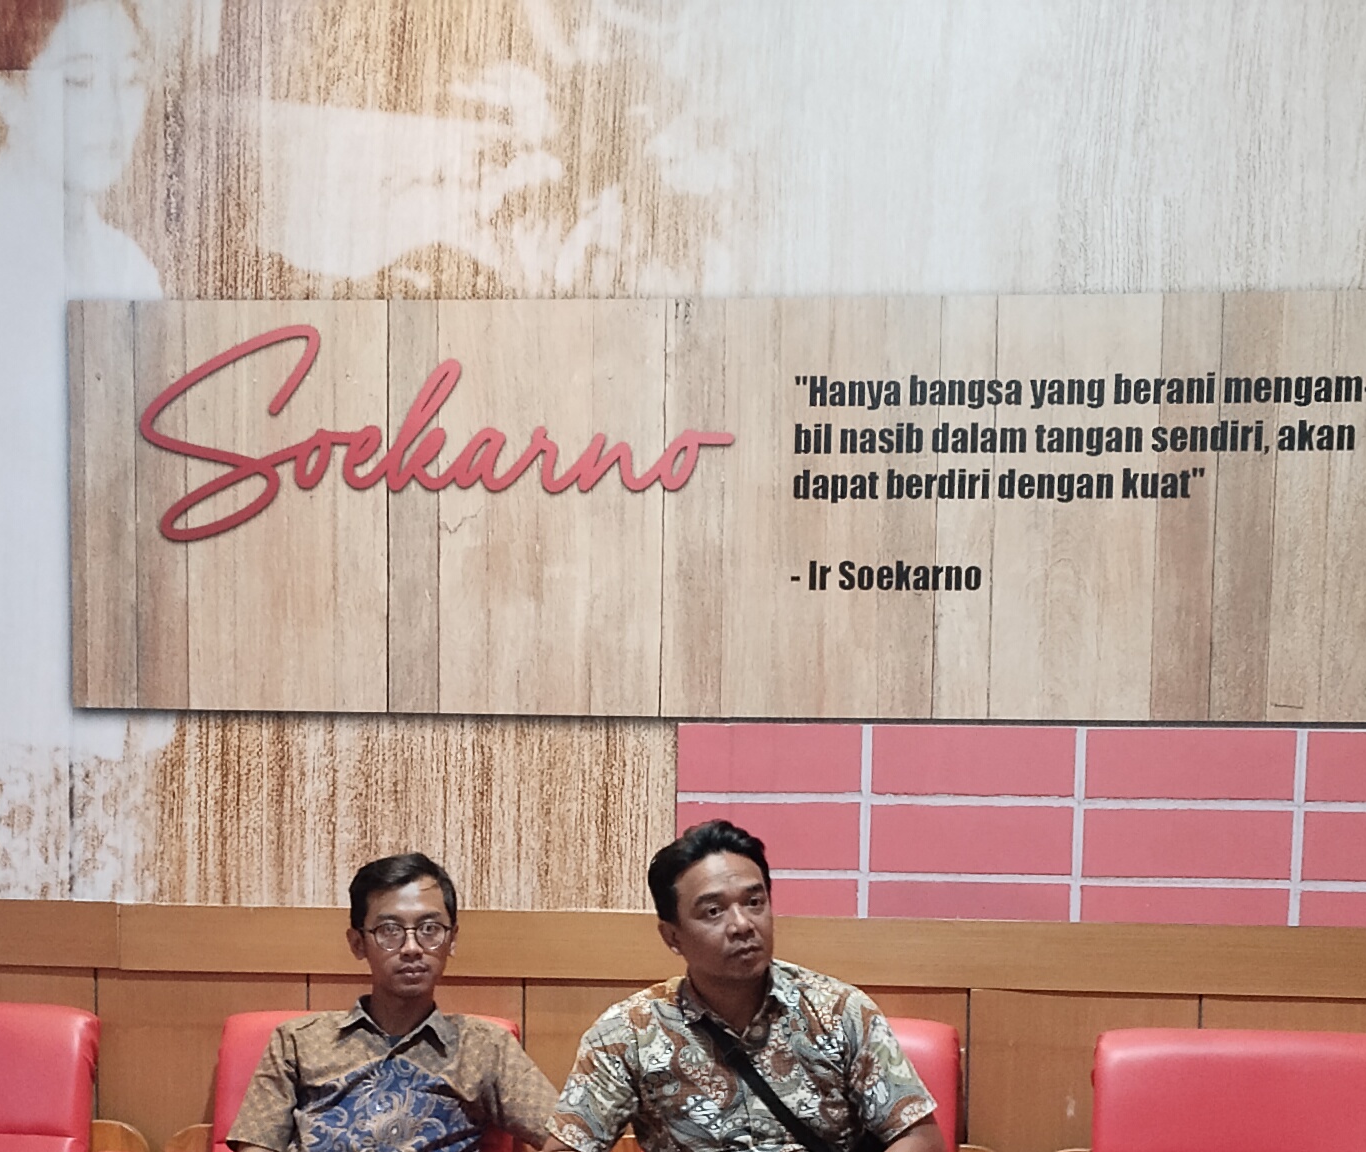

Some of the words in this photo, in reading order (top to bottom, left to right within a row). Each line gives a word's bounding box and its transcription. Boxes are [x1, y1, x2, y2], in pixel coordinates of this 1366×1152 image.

[795, 375, 901, 410] "Hanya
[909, 374, 1022, 410] bangsa
[1030, 375, 1105, 410] yang
[1114, 372, 1215, 405] berani
[140, 325, 734, 541] Soekarno
[794, 423, 832, 455] bil
[839, 422, 923, 454] nasib
[931, 421, 1026, 453] dalam
[1035, 423, 1143, 457] tangan
[1151, 420, 1269, 455] sendiri,
[1277, 420, 1355, 452] akan
[793, 470, 878, 504] dapat
[886, 469, 990, 500] berdiri
[997, 468, 1114, 503] dengan
[1122, 467, 1205, 499] kuat"
[809, 561, 831, 590] Ir
[839, 561, 982, 591] Soekarno
